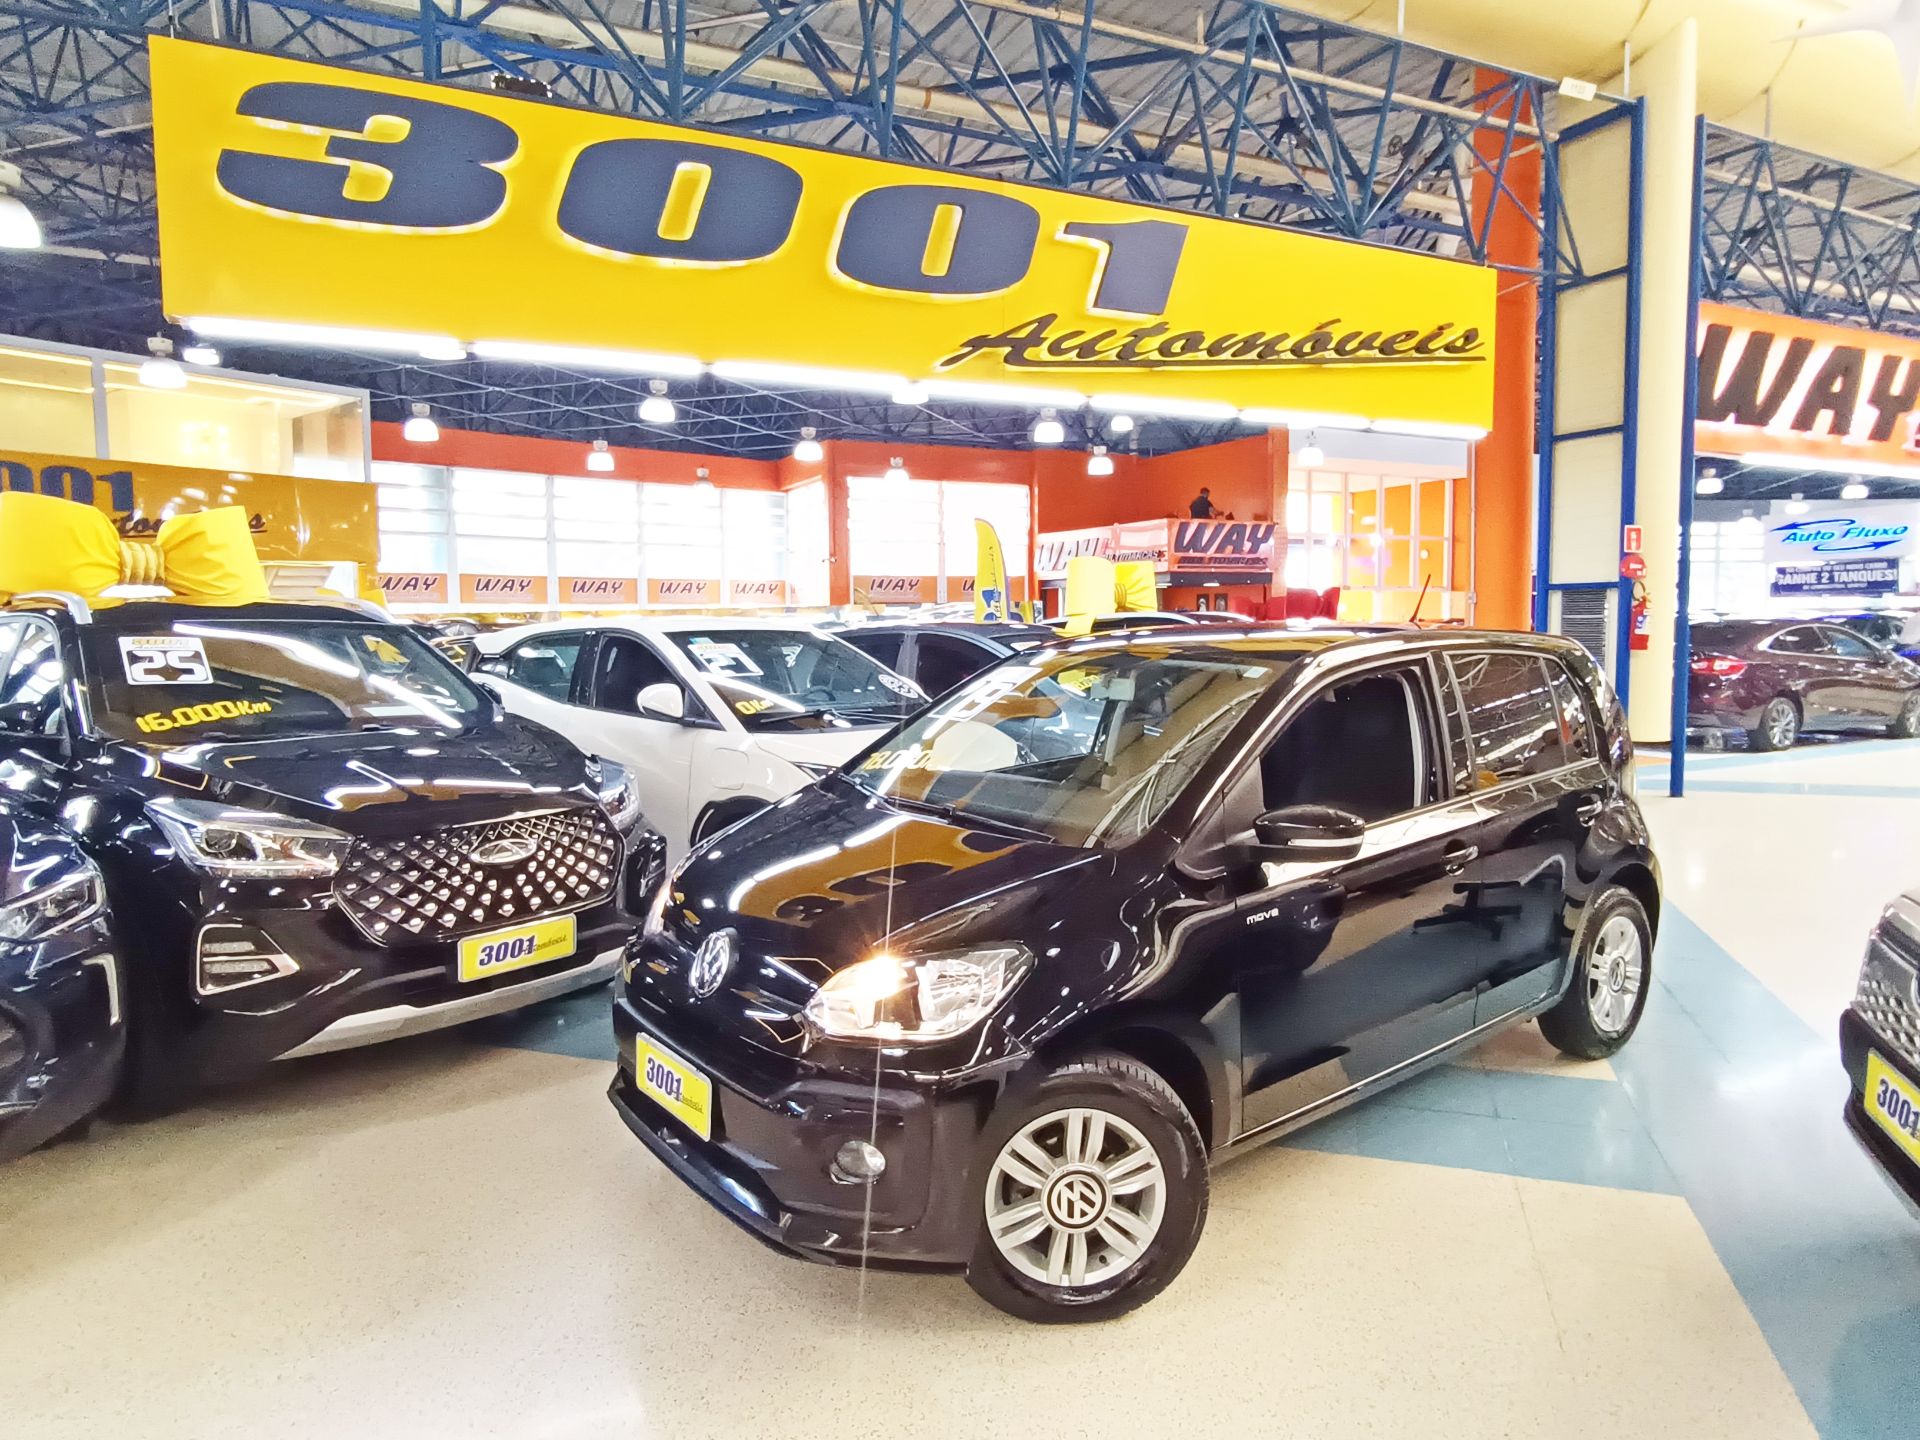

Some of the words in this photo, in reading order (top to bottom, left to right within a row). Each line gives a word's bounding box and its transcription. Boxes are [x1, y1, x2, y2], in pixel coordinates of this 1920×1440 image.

[216, 81, 1189, 315] 3001
[942, 313, 1486, 369] Automóveis
[1695, 323, 1920, 442] WAY
[1174, 521, 1277, 554] WAY
[1782, 530, 1835, 542] Auto
[1841, 525, 1909, 538] Fluxo
[380, 576, 438, 592] WAY
[475, 577, 532, 592] WAY
[870, 578, 920, 592] WAY
[1777, 572, 1818, 585] GANHE
[1820, 571, 1830, 583] 2
[572, 580, 623, 594] WAY
[659, 582, 707, 594] WAY
[735, 583, 779, 594] WAY
[1246, 907, 1279, 925] move
[479, 935, 535, 966] 3001
[647, 1057, 682, 1102] 3001
[1877, 1078, 1920, 1139] 3001
